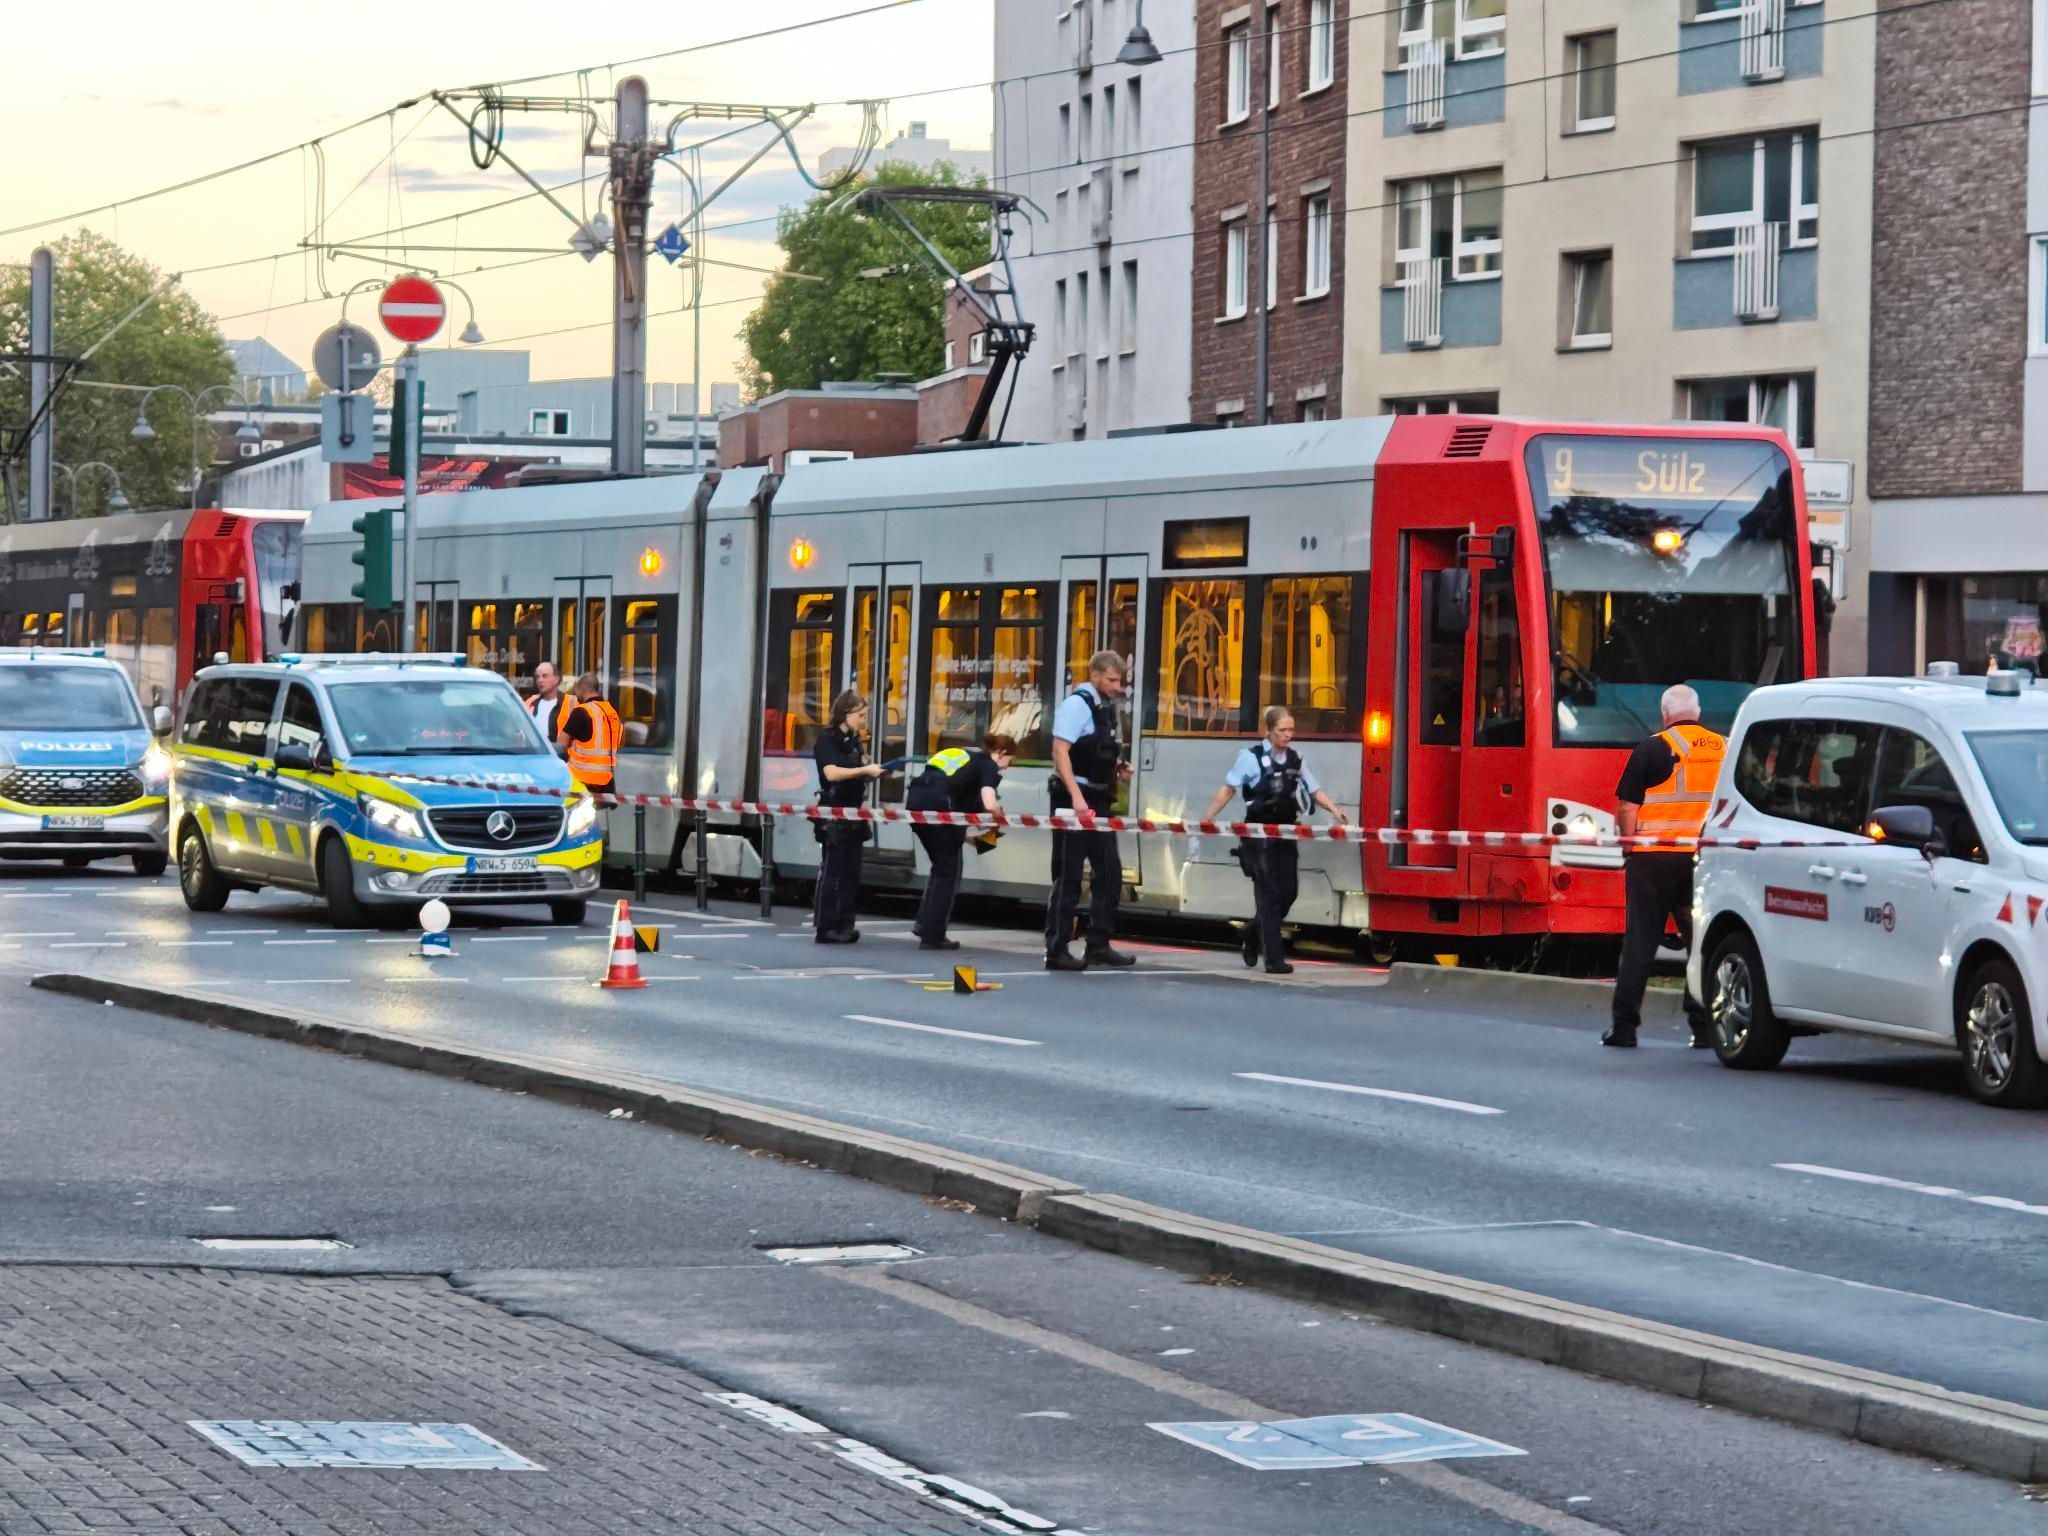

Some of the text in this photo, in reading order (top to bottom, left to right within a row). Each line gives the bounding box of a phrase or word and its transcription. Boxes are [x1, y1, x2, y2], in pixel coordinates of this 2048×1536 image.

[1553, 448, 1706, 493] 9 Sülz
[20, 742, 113, 752] POLIZEI
[274, 789, 305, 810] POLIZEI
[511, 857, 537, 870] 6594
